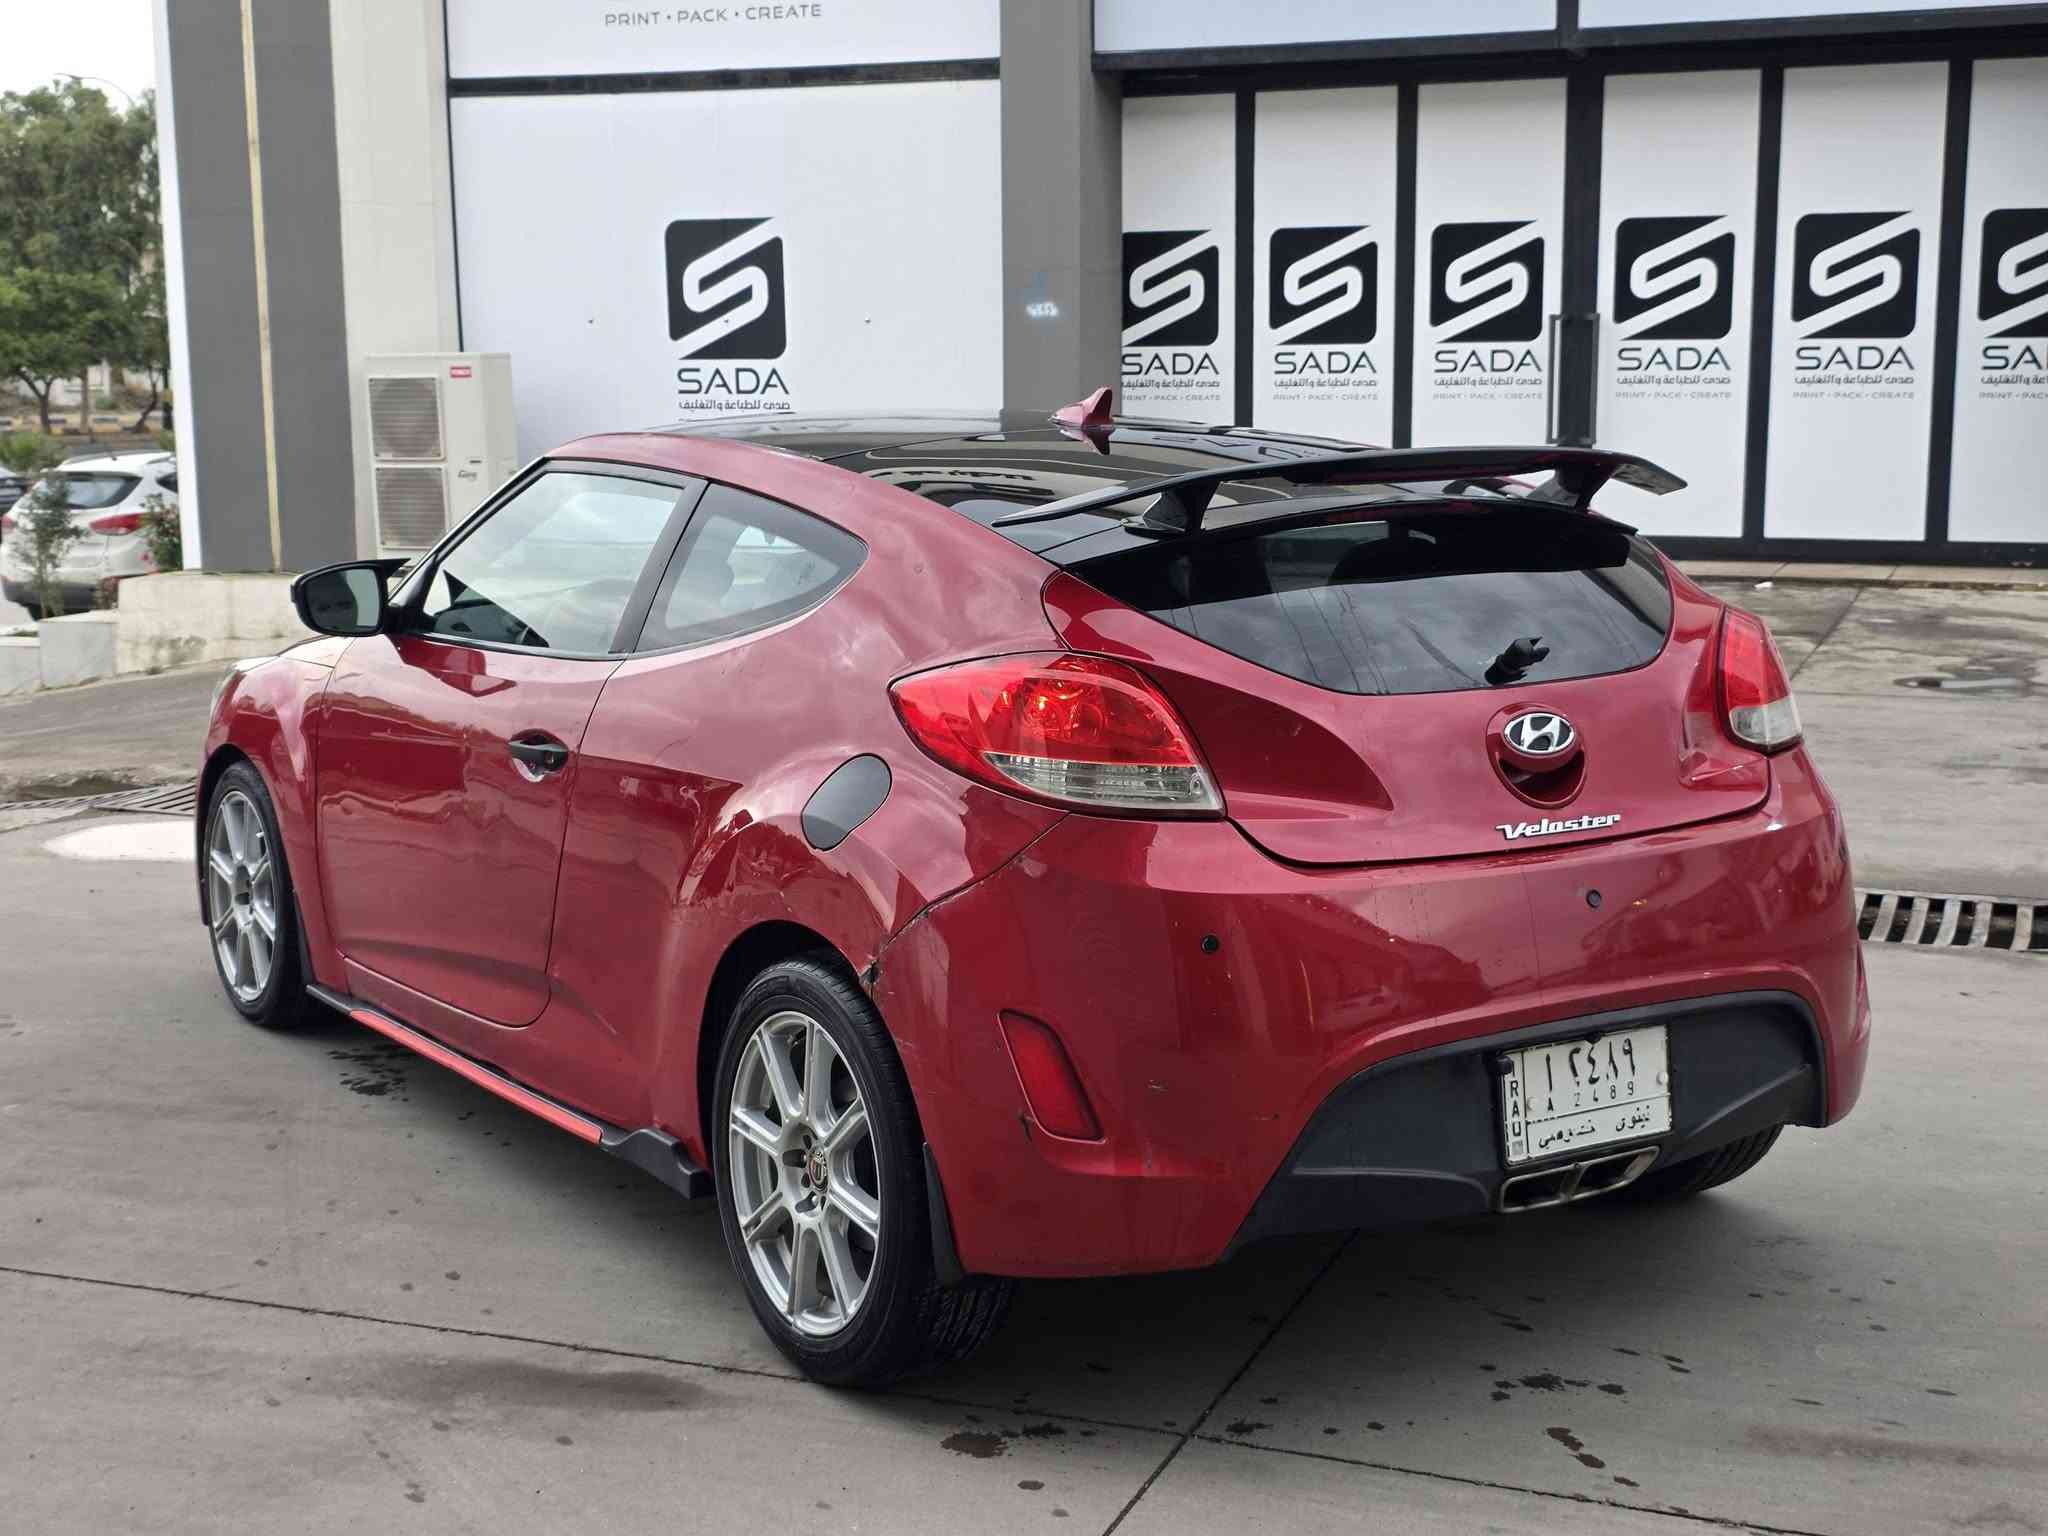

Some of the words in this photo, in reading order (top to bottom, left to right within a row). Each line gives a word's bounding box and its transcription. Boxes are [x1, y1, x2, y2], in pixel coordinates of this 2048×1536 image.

[604, 11, 661, 27] PRINT
[677, 8, 728, 23] PACK
[745, 4, 822, 20] CREATE
[1121, 352, 1220, 375] SADA
[1274, 351, 1376, 374] SADA
[1434, 349, 1542, 372] SADA
[1616, 347, 1731, 370] SADA
[1795, 346, 1914, 370] SADA
[677, 367, 790, 394] SADA
[1496, 814, 1621, 840] Veloster
